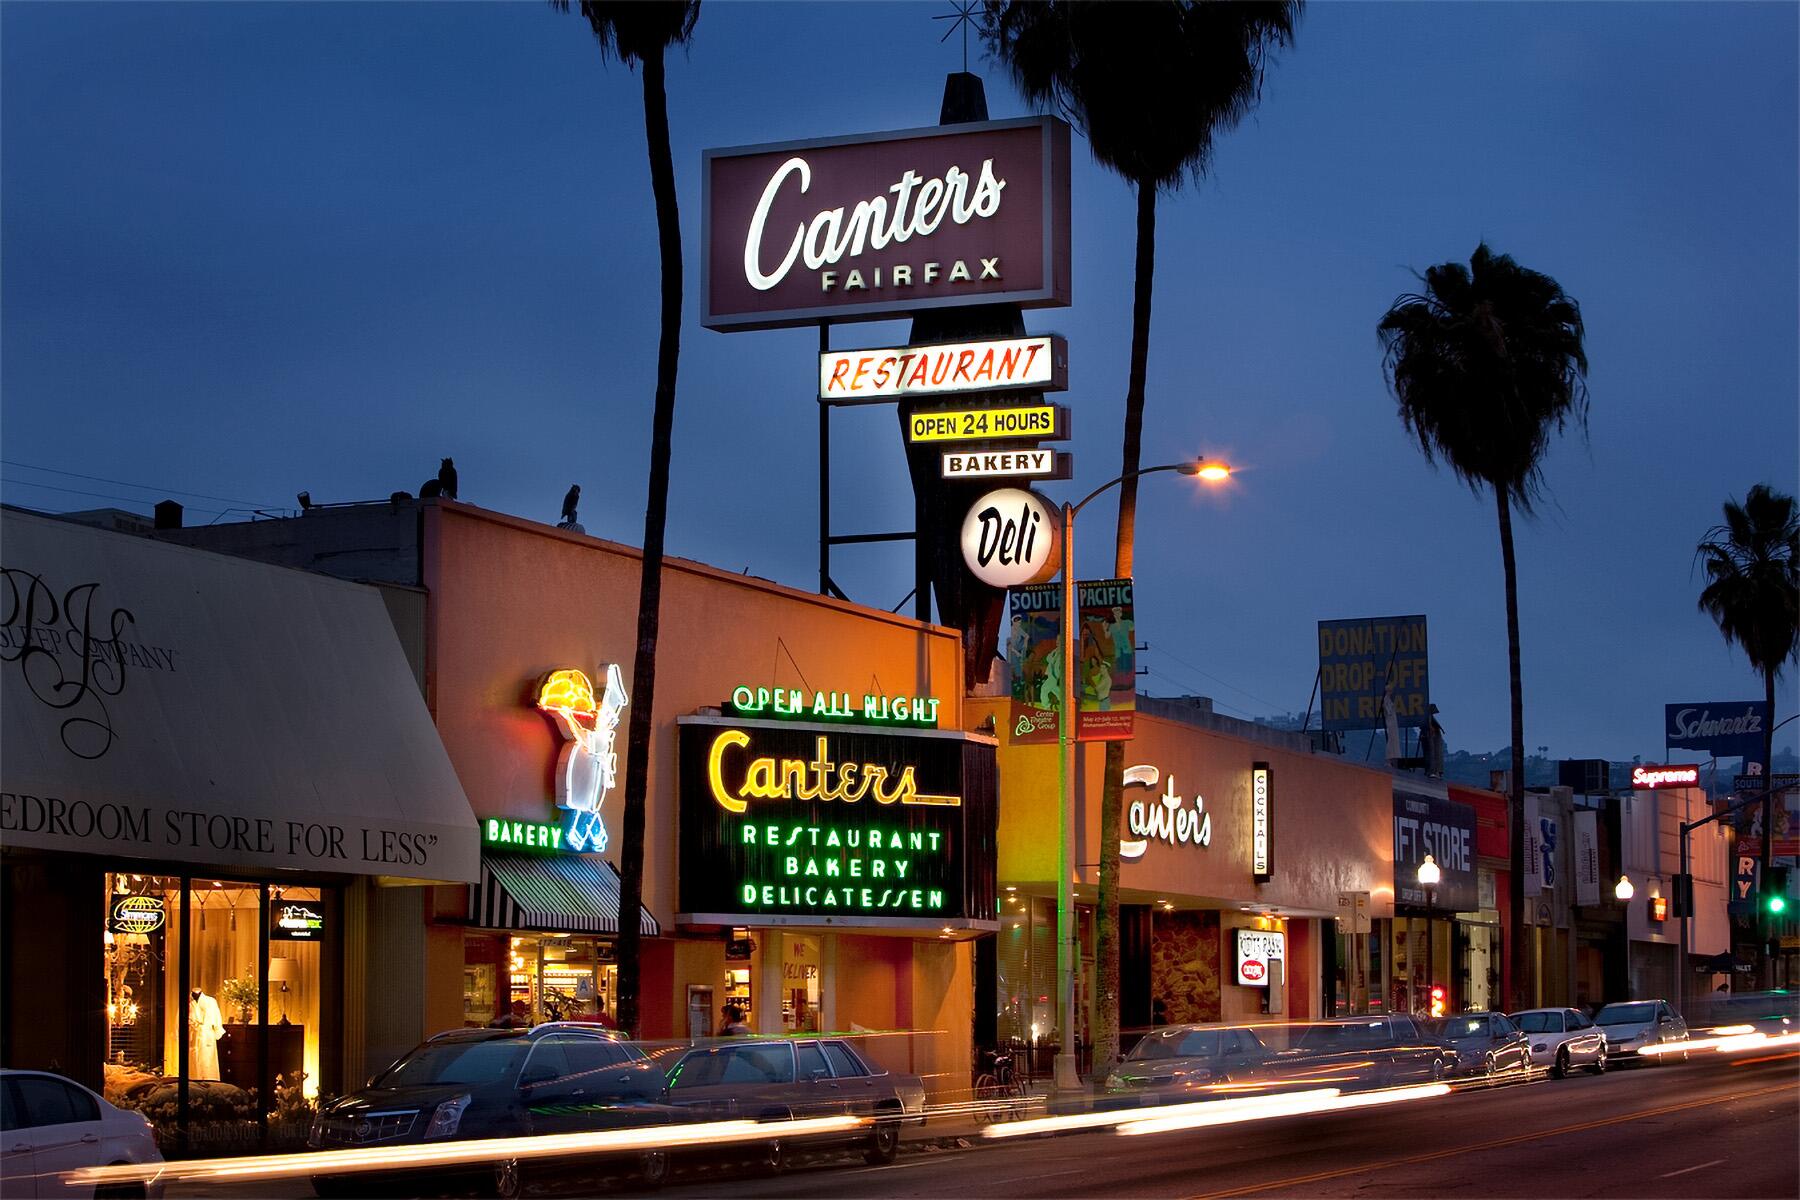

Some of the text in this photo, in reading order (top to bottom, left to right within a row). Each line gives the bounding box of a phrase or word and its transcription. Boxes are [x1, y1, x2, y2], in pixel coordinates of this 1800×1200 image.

[744, 157, 1006, 291] Canters
[821, 257, 1003, 293] FAIRFAX
[828, 344, 1044, 392] RESTAURANT
[914, 411, 1050, 436] OPEN 24 HOURS
[949, 454, 1045, 472] BAKERY
[977, 502, 1041, 567] Deli
[1011, 586, 1132, 610] SOUTH PACIFIC
[1320, 623, 1425, 657] DONATION
[1321, 658, 1426, 692] DROP-OFF
[732, 686, 940, 722] OPEN ALL NIGHT
[1324, 697, 1350, 720] IN
[1668, 706, 1762, 739] Schwartz
[1632, 768, 1697, 788] Supreme
[165, 809, 275, 853] STORE
[287, 821, 348, 859] FOR
[487, 819, 562, 848] BAKERY
[743, 825, 941, 850] RESTAURANT
[1256, 775, 1265, 870] COCKTAILS
[1394, 816, 1419, 864] IFT
[1422, 821, 1471, 872] STORE
[786, 856, 909, 878] BAKERY
[744, 885, 942, 908] DELICATESSEN
[793, 943, 805, 957] WE
[783, 963, 817, 979] DELIVER
